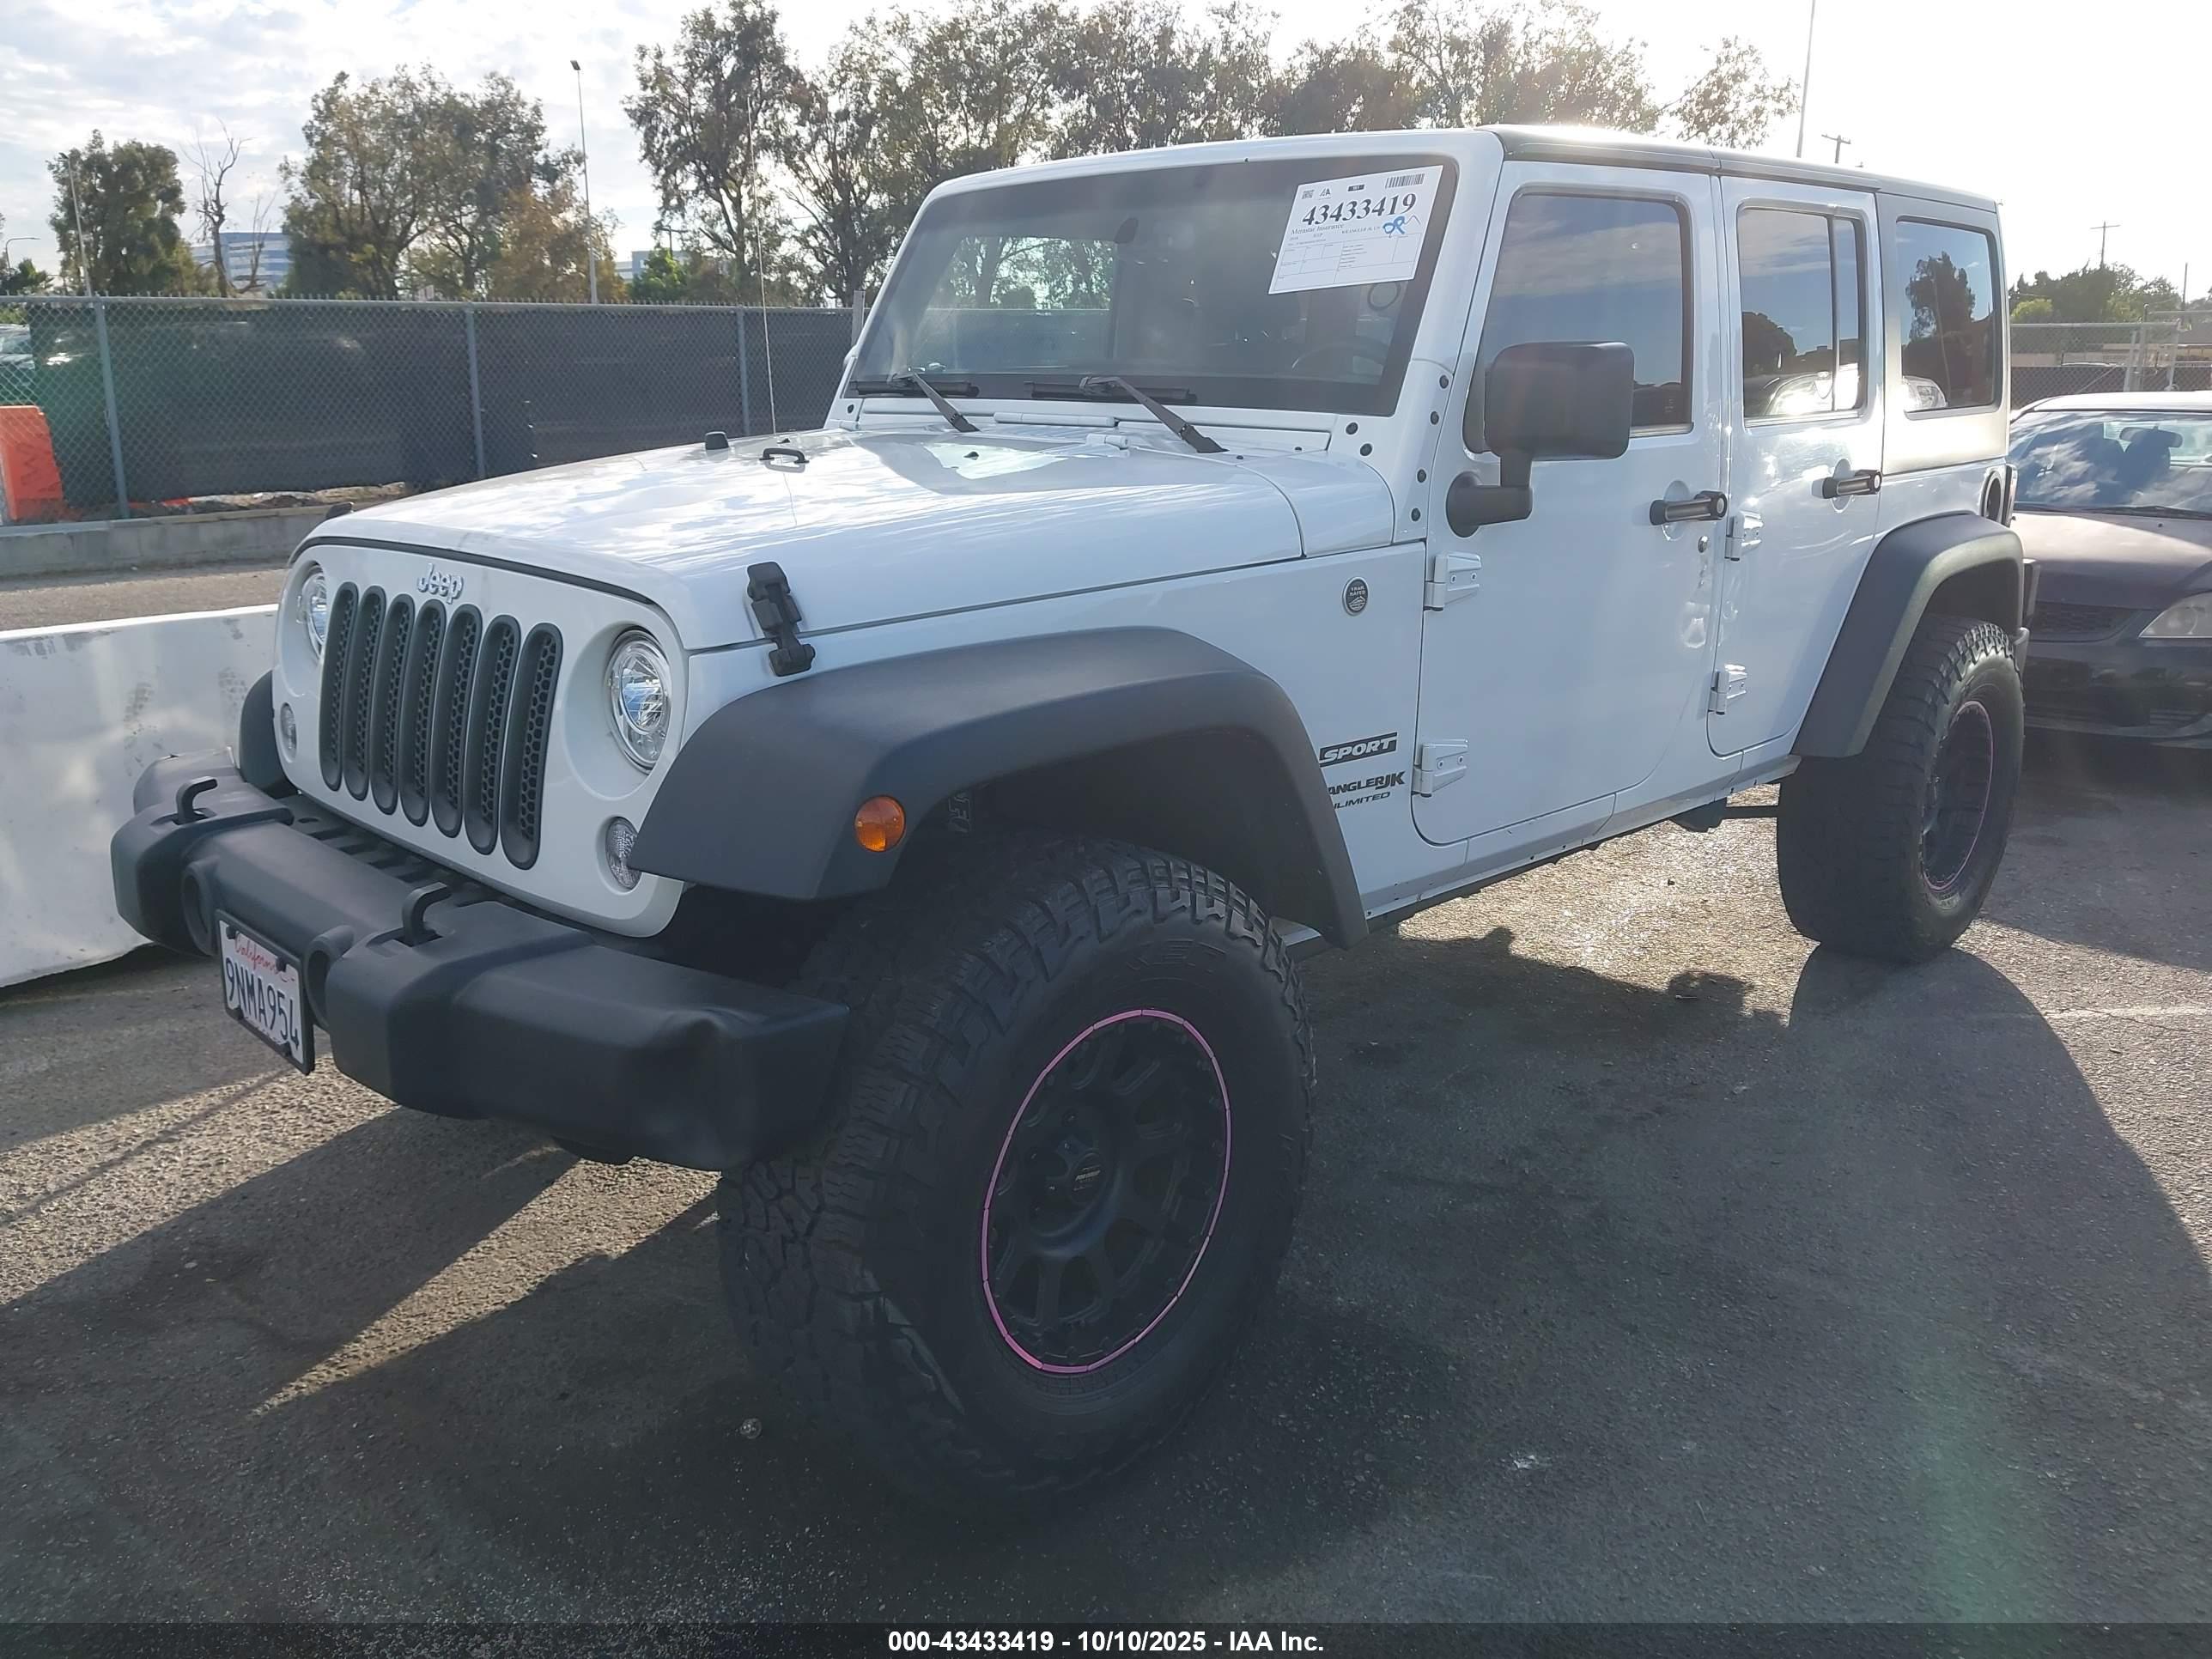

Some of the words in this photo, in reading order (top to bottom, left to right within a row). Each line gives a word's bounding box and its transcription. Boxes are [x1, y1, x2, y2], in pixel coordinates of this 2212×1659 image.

[1302, 193, 1417, 226] 43433419
[416, 563, 464, 605] Jeep
[1319, 735, 1396, 763] SPORT
[1334, 791, 1391, 809] LIMITED
[225, 957, 299, 1050] 9NMA954
